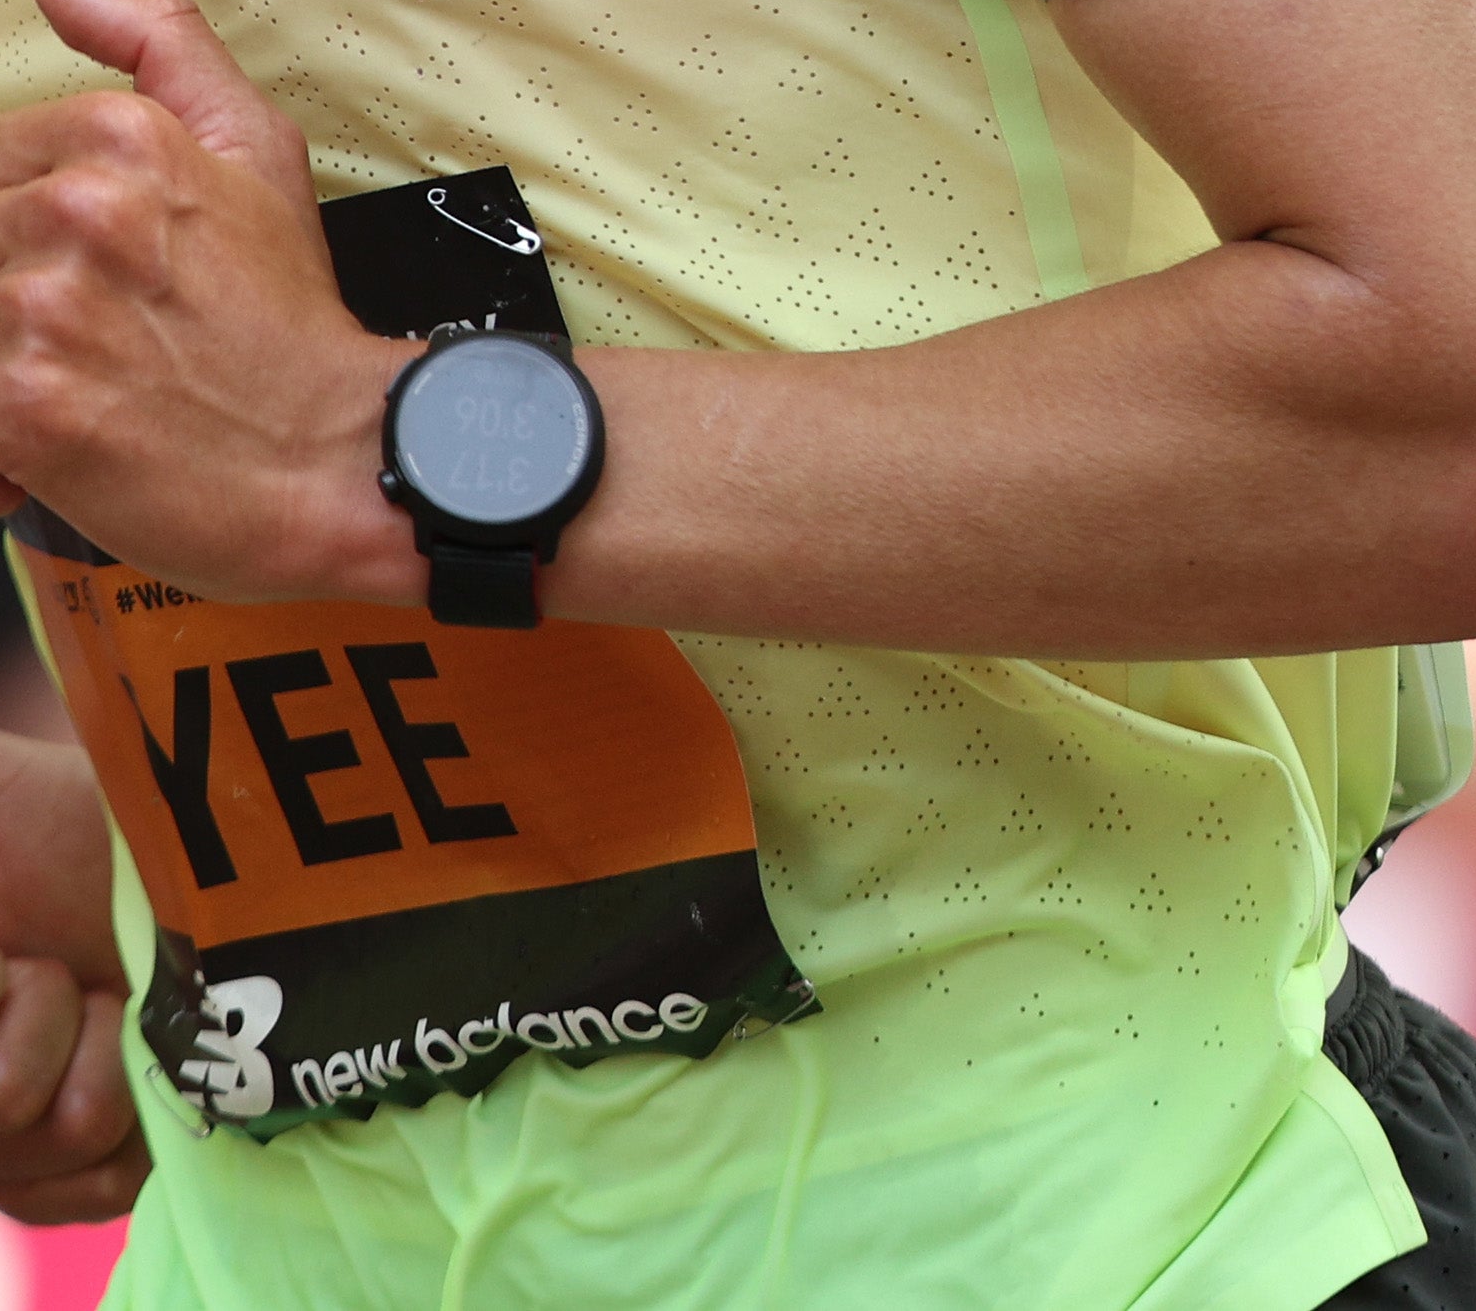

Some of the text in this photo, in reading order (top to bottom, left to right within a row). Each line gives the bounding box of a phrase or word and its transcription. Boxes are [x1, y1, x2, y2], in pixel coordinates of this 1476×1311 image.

[116, 580, 205, 614] #We
[121, 641, 519, 890] YEE
[291, 1039, 408, 1109] new
[414, 991, 709, 1077] balance
